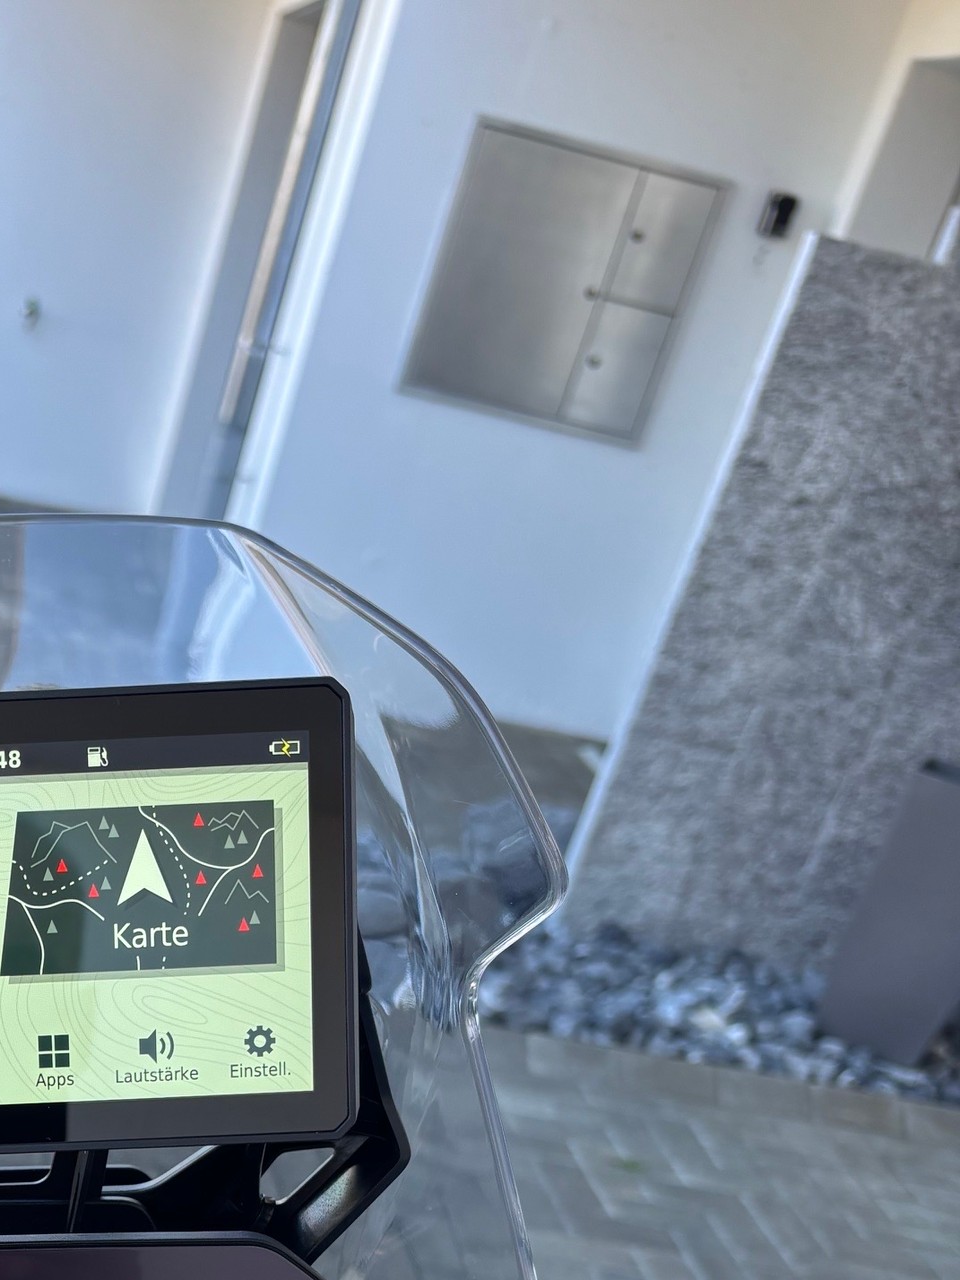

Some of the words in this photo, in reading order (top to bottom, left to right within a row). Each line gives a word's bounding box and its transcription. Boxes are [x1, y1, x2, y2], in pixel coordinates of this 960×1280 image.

[113, 921, 189, 949] Karte
[115, 1066, 199, 1084] Lautstärke
[230, 1061, 292, 1079] Einstell.
[35, 1073, 75, 1091] Apps
